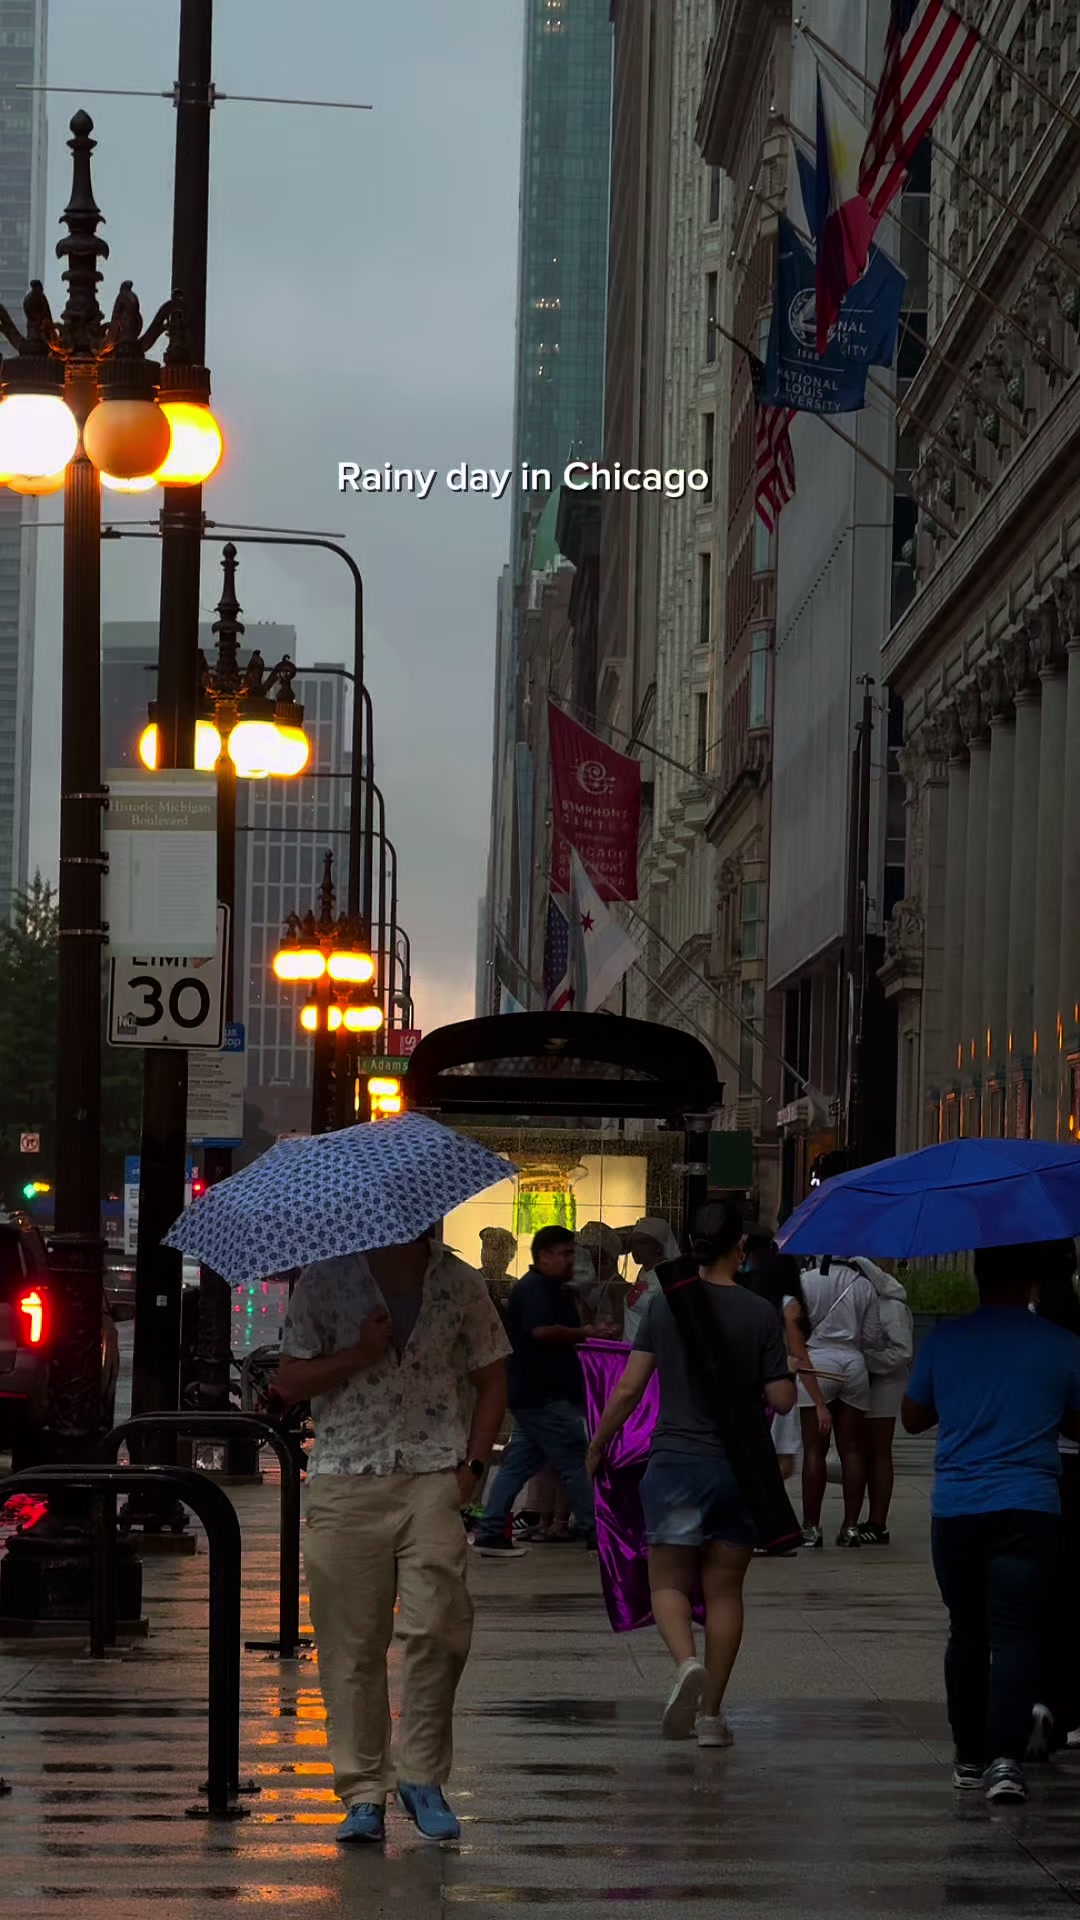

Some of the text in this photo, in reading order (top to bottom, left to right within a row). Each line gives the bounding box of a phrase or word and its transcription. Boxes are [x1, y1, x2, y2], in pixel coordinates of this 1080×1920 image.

[785, 382, 824, 398] LOUIS
[109, 799, 211, 814] Historic Michigan
[131, 814, 189, 826] Boulevard
[127, 976, 210, 1029] 30
[370, 1058, 409, 1072] Adams
